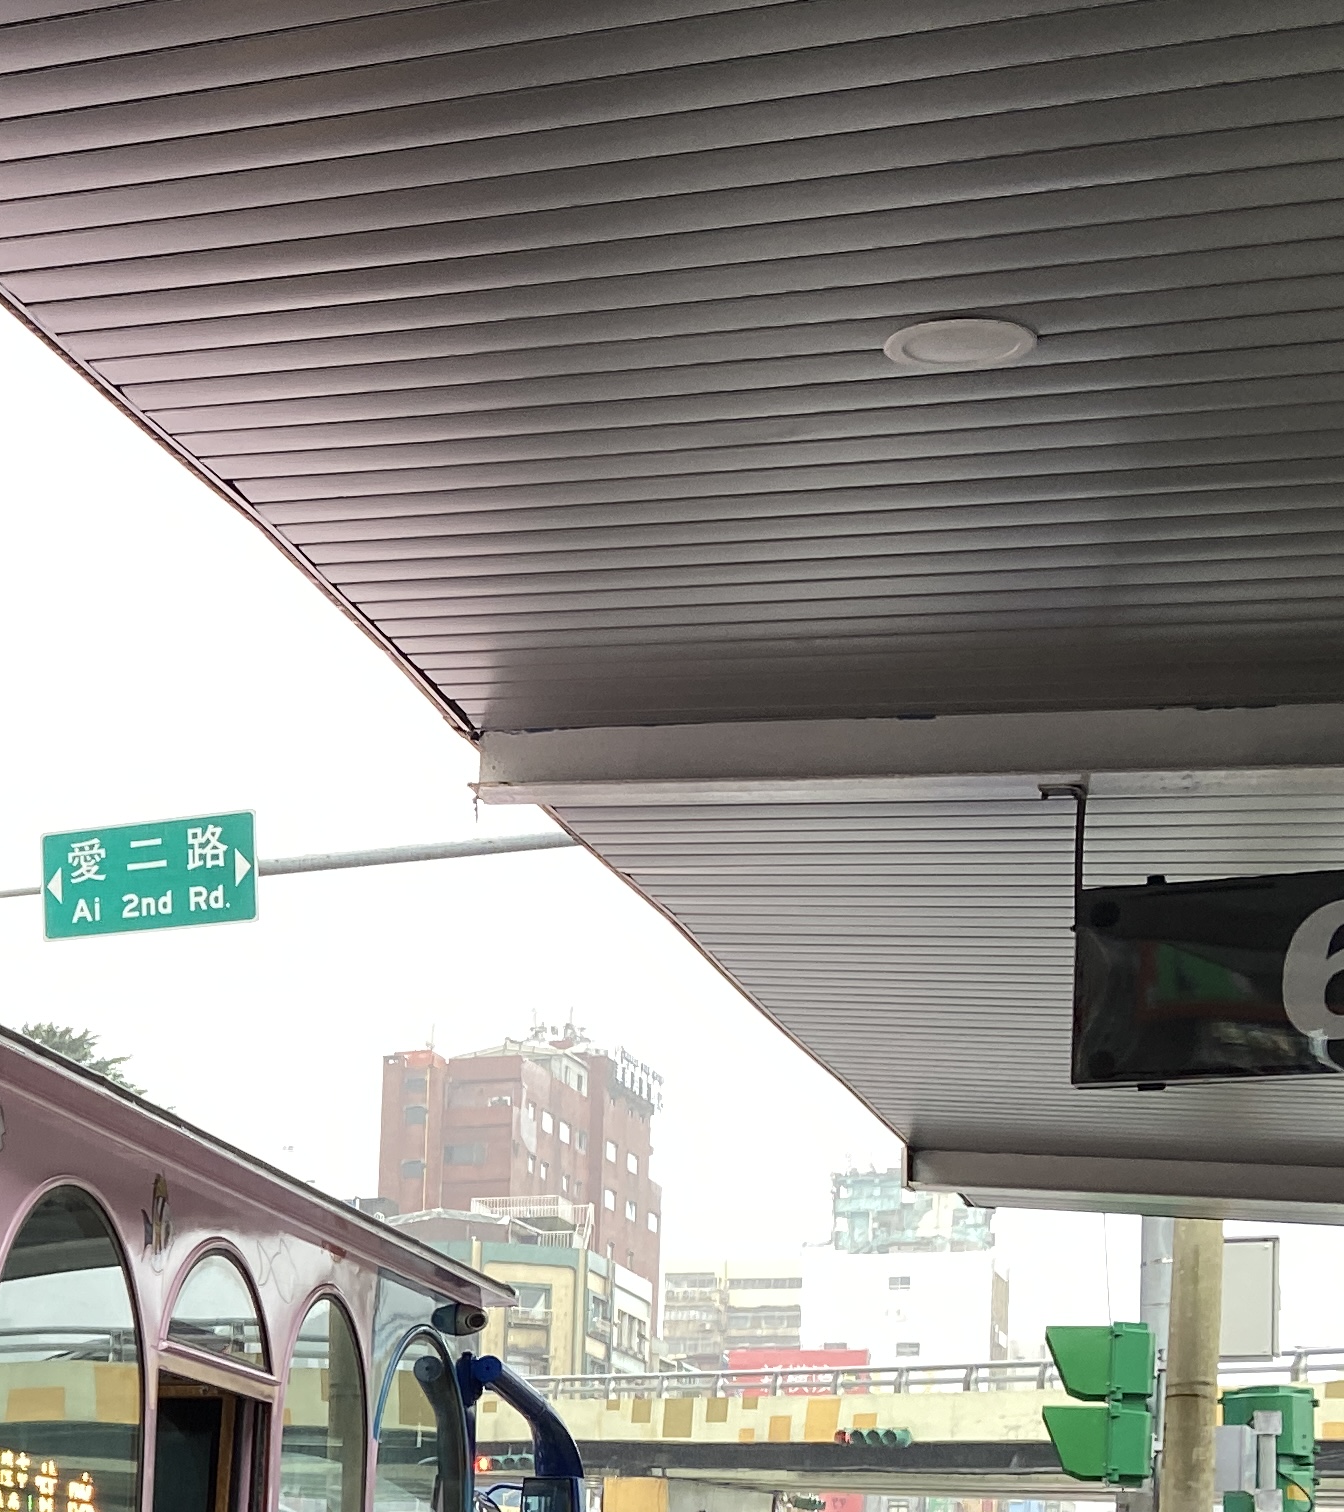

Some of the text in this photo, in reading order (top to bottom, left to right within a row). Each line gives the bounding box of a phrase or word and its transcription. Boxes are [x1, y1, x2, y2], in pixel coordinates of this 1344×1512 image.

[67, 824, 228, 884] 愛二路
[72, 885, 231, 924] Ai 2nd Rd.
